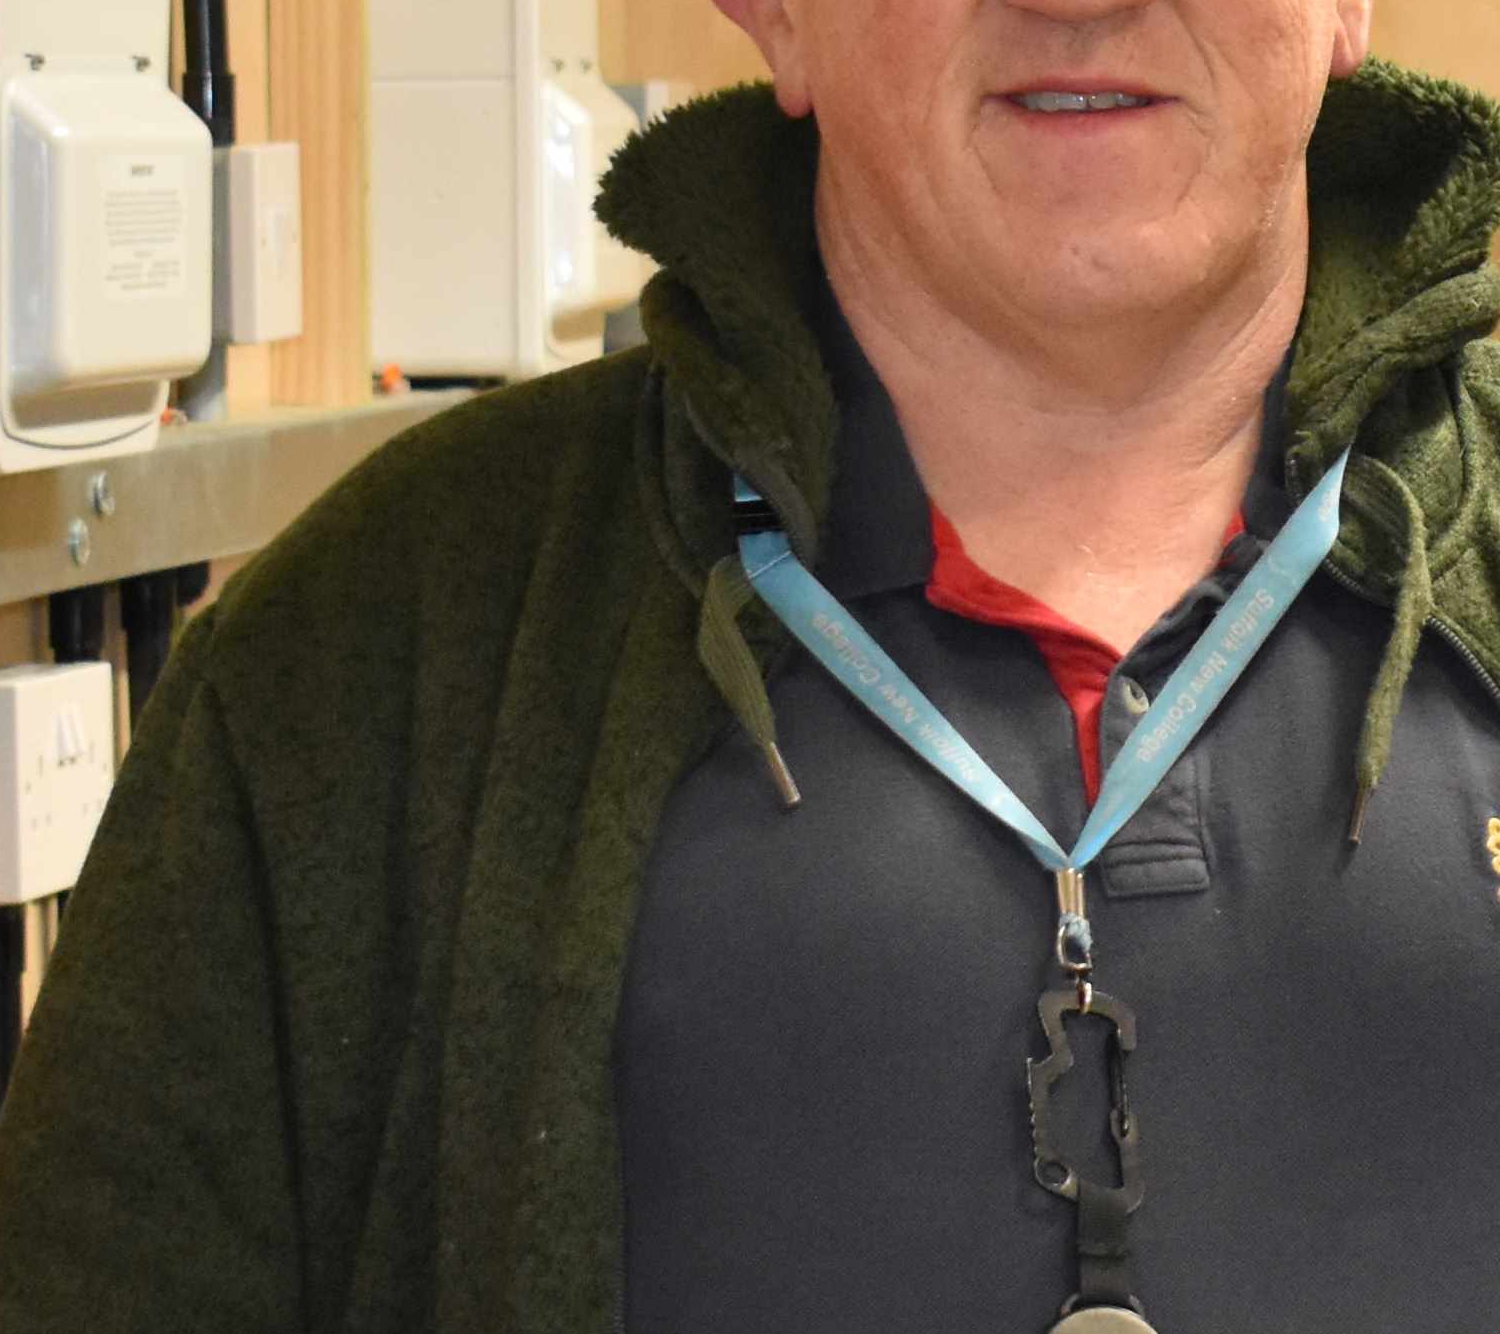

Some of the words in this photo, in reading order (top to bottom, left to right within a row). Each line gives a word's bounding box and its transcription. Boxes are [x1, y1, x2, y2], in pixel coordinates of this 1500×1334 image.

[812, 612, 882, 685] College
[1193, 650, 1229, 698] New
[877, 683, 918, 724] New
[1135, 692, 1198, 764] College
